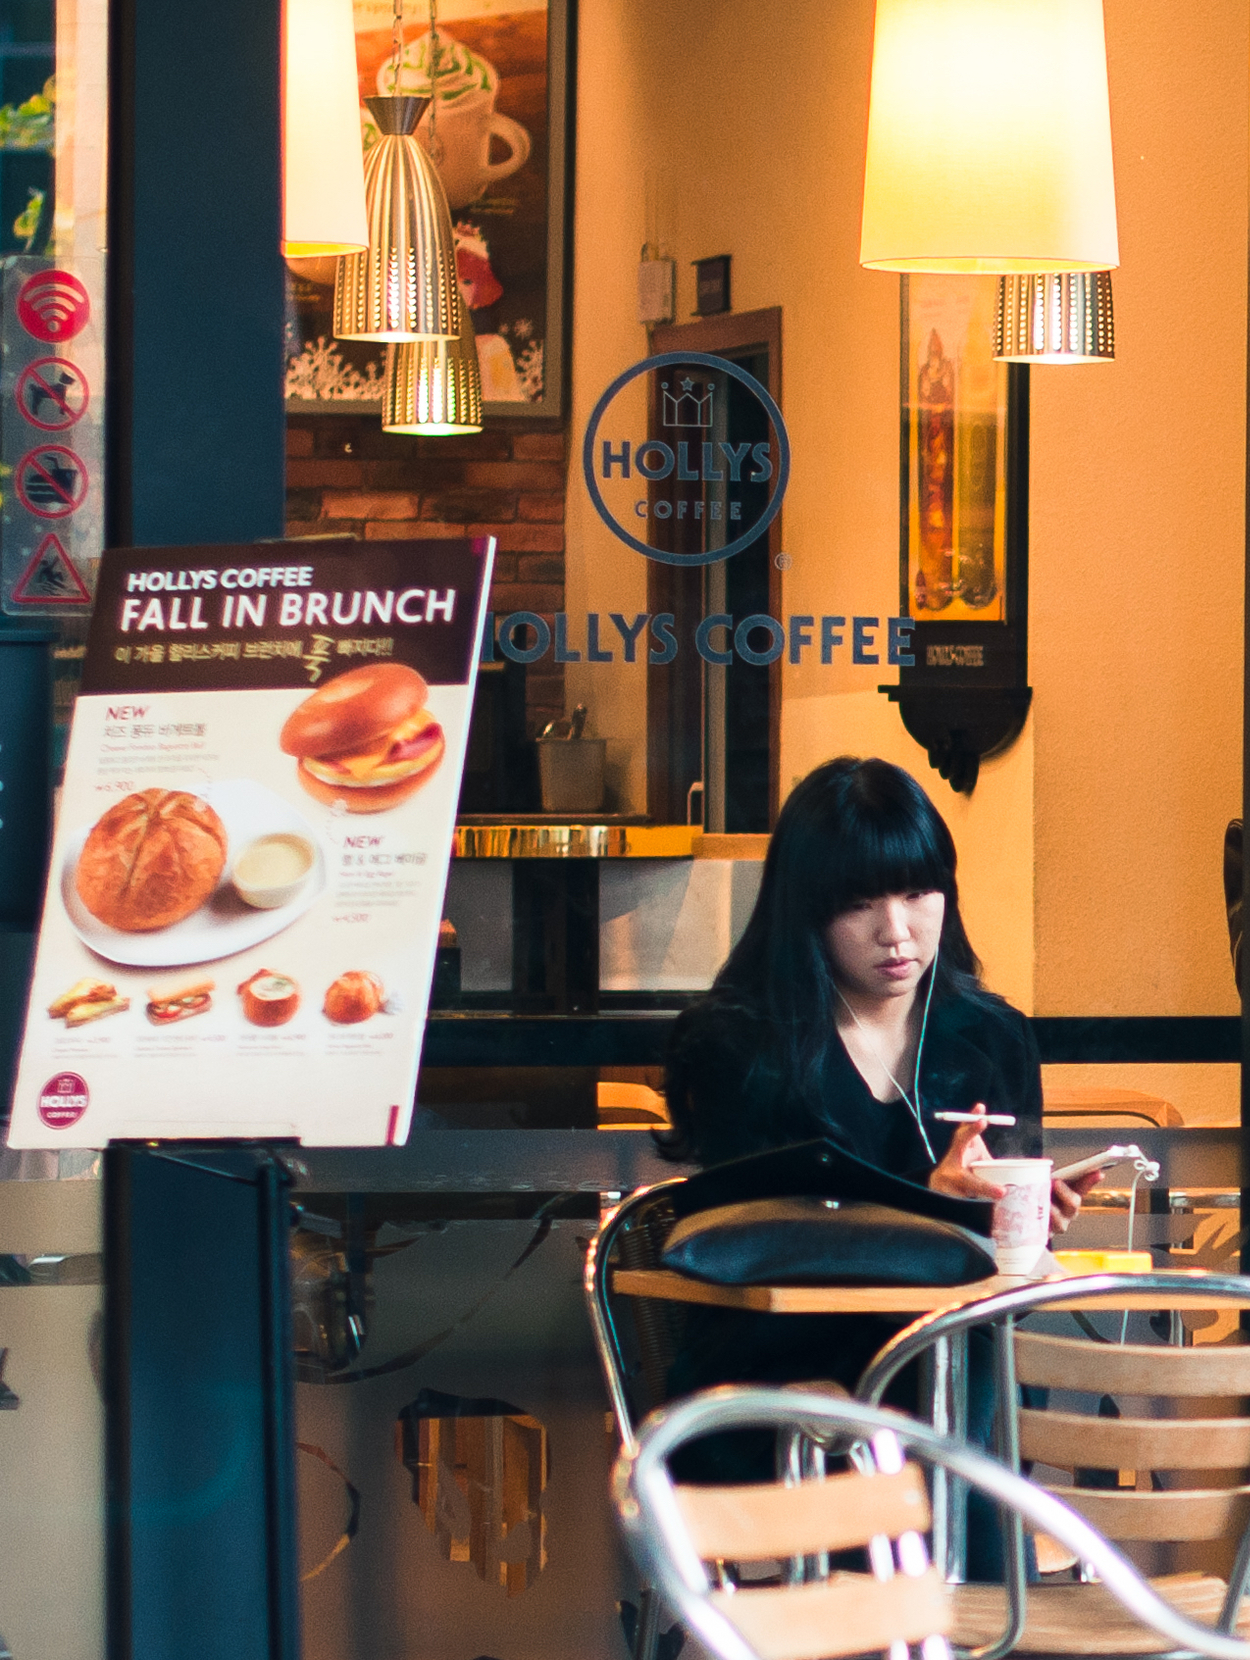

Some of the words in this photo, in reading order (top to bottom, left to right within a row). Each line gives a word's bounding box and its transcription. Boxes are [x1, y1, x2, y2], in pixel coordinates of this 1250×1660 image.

[603, 440, 773, 482] HOLLYS
[634, 500, 742, 521] COFFEE
[127, 569, 218, 592] HOLLYS
[220, 566, 314, 589] COFFEE
[120, 596, 208, 631] FALL
[221, 594, 267, 628] IN
[279, 588, 456, 626] BRUNCH
[694, 613, 916, 667] COFFEE
[105, 704, 151, 721] NEW
[343, 834, 385, 850] NEW
